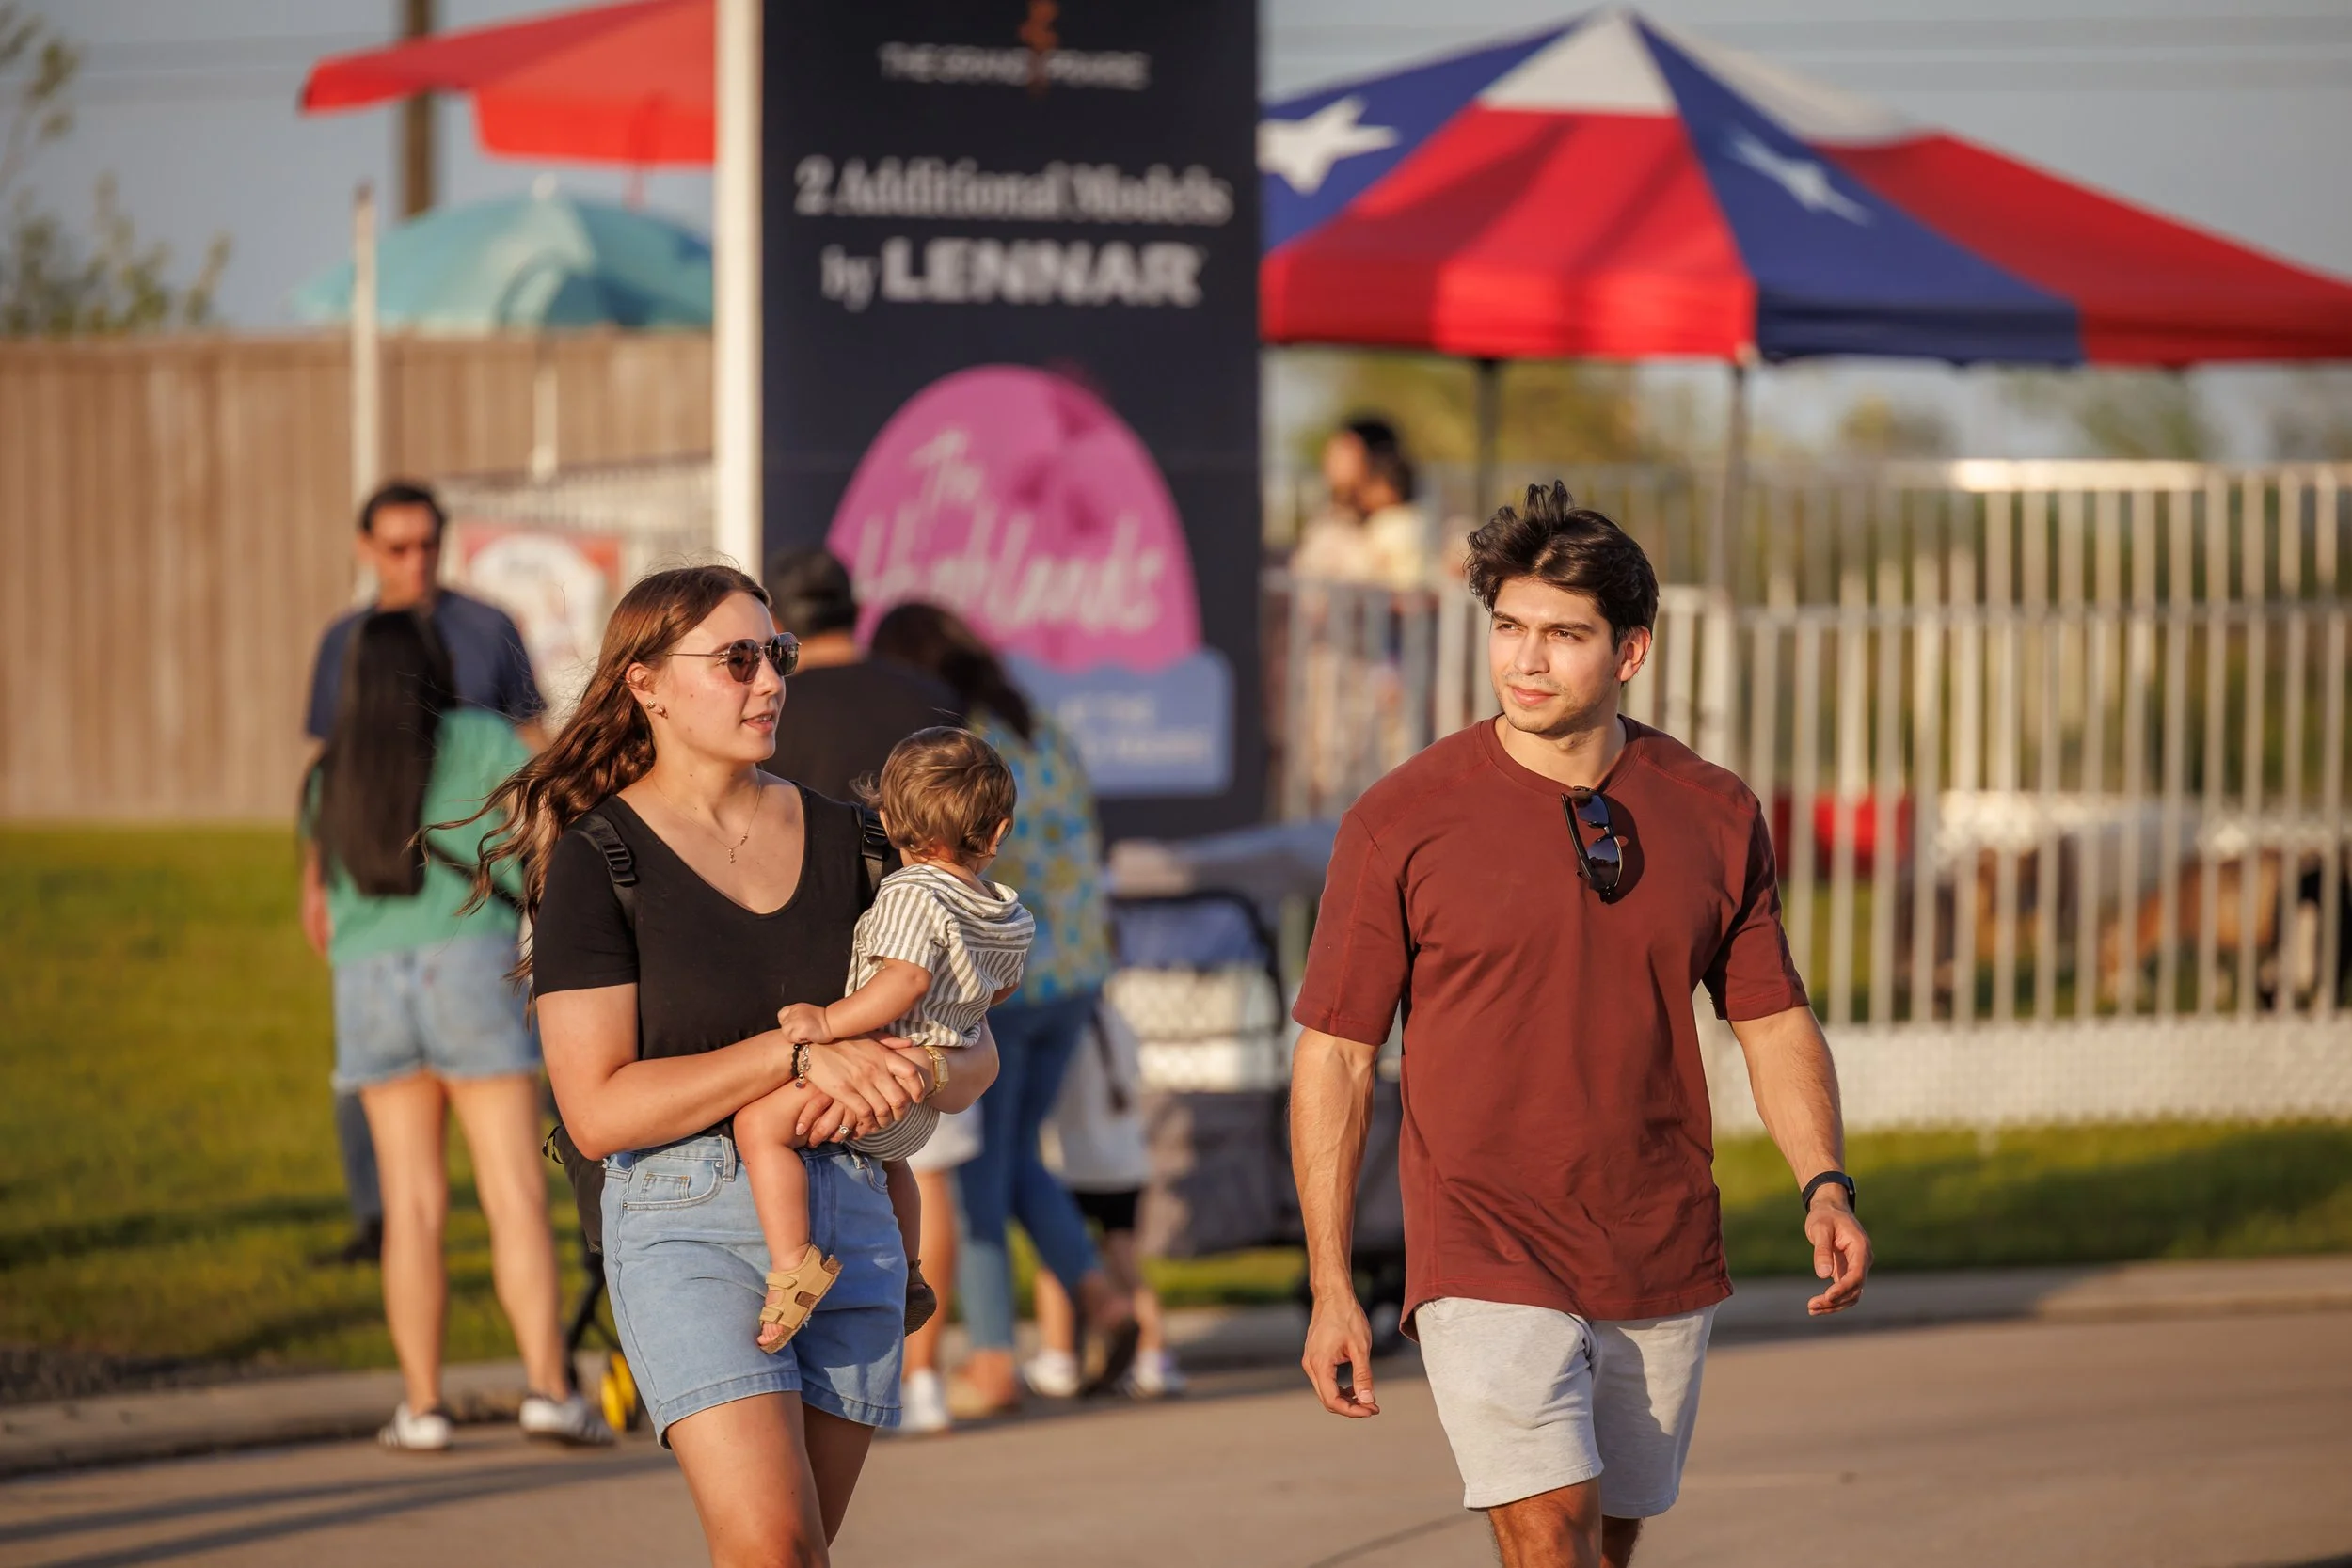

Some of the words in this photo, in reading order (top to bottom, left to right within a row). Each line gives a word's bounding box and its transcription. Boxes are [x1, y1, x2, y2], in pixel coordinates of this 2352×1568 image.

[794, 155, 834, 215] 2
[835, 156, 1062, 220] Additional
[1066, 162, 1233, 226] Models
[820, 243, 879, 313] by
[882, 236, 1203, 308] LENNAR
